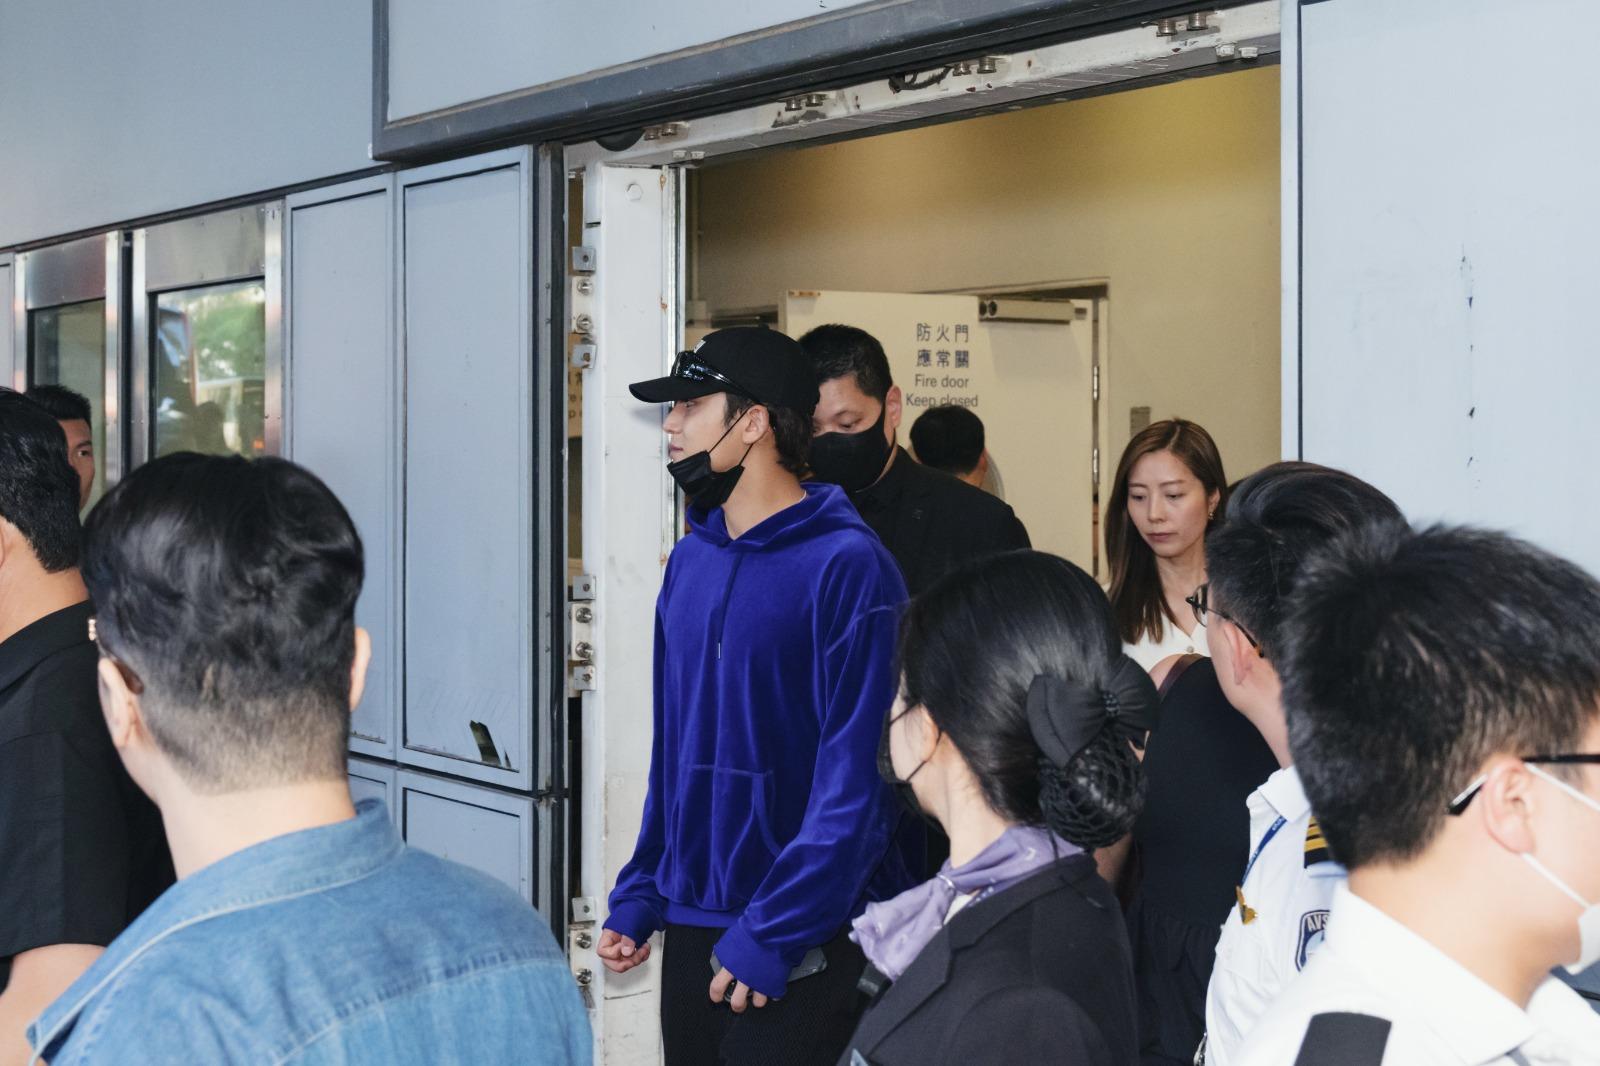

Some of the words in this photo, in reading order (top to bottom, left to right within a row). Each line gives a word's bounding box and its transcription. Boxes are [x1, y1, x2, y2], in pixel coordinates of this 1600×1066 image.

[916, 323, 969, 343] 防火門
[916, 349, 969, 368] 應常關
[915, 373, 938, 388] Fire
[941, 373, 969, 388] door
[906, 393, 936, 409] Keep
[940, 394, 978, 407] closed
